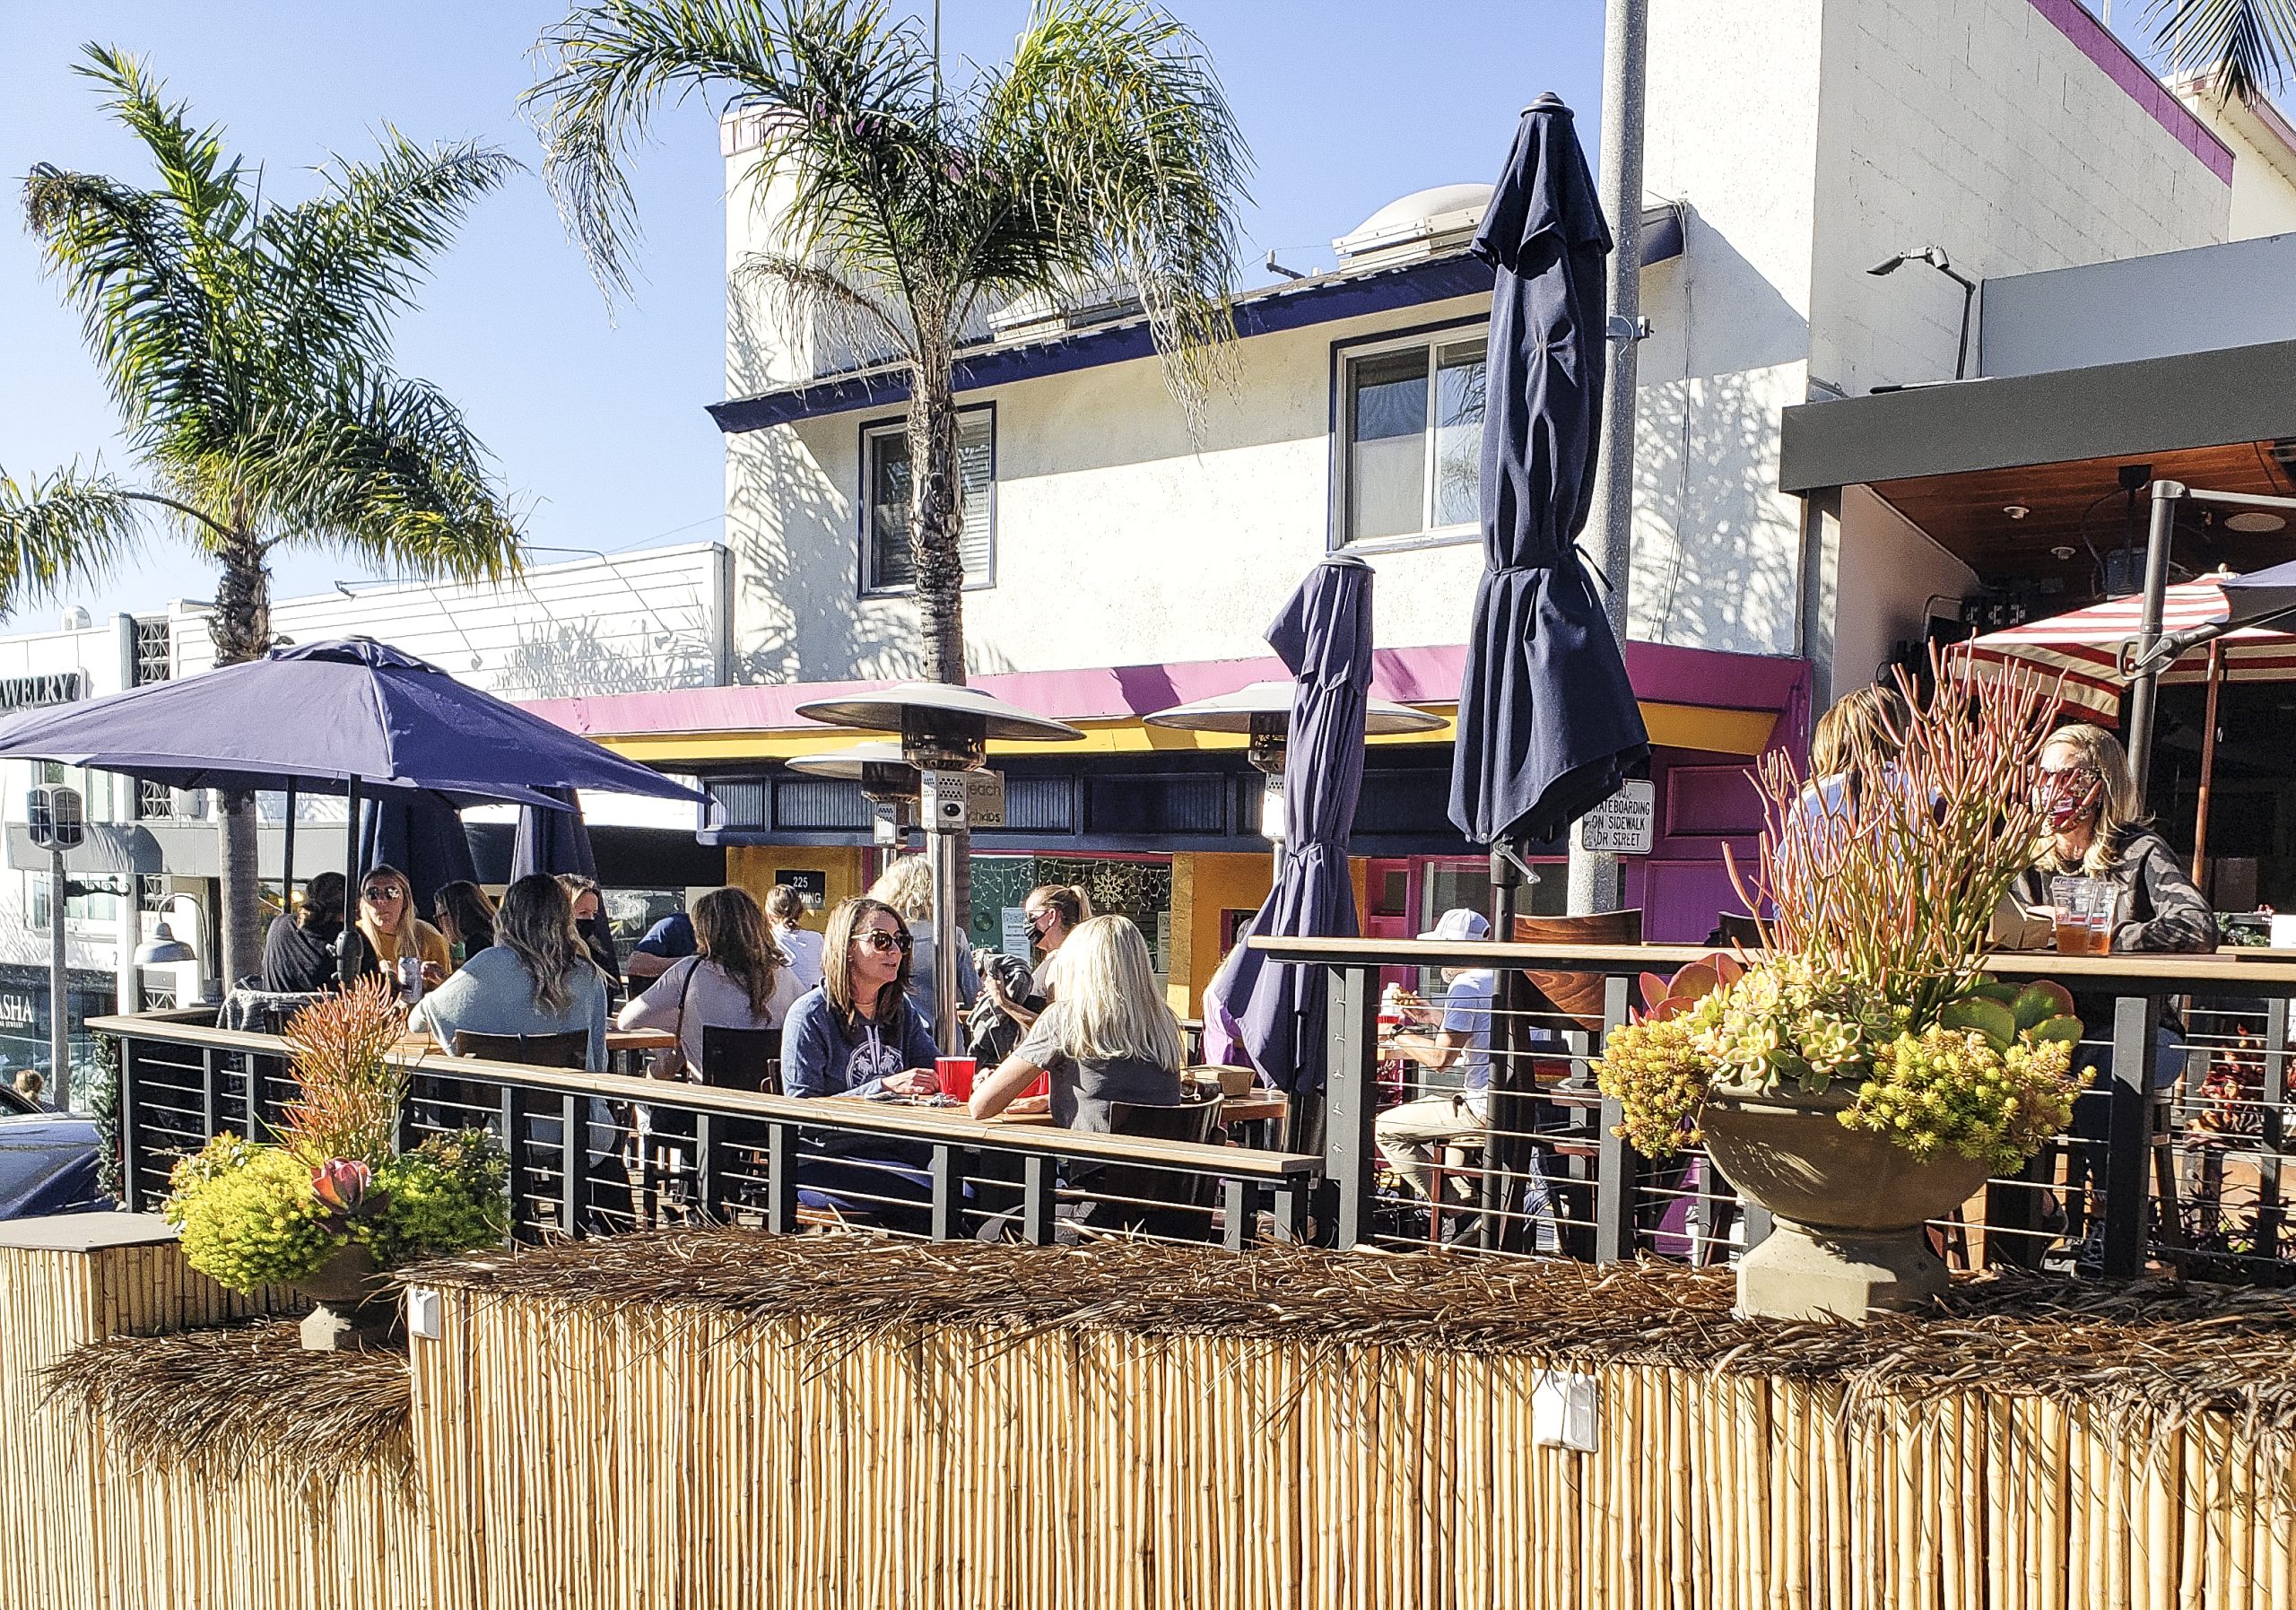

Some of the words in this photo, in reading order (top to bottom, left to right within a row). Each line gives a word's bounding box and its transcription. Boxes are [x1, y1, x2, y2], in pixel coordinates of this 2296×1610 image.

[0, 673, 69, 708] WELRY
[970, 782, 1002, 797] each
[1593, 800, 1650, 815] ATEBOARDING
[1591, 814, 1605, 829] ON
[1608, 815, 1646, 831] SIDEWALK
[1613, 831, 1640, 847] STREET
[793, 875, 808, 888] 225
[798, 892, 822, 904] DING
